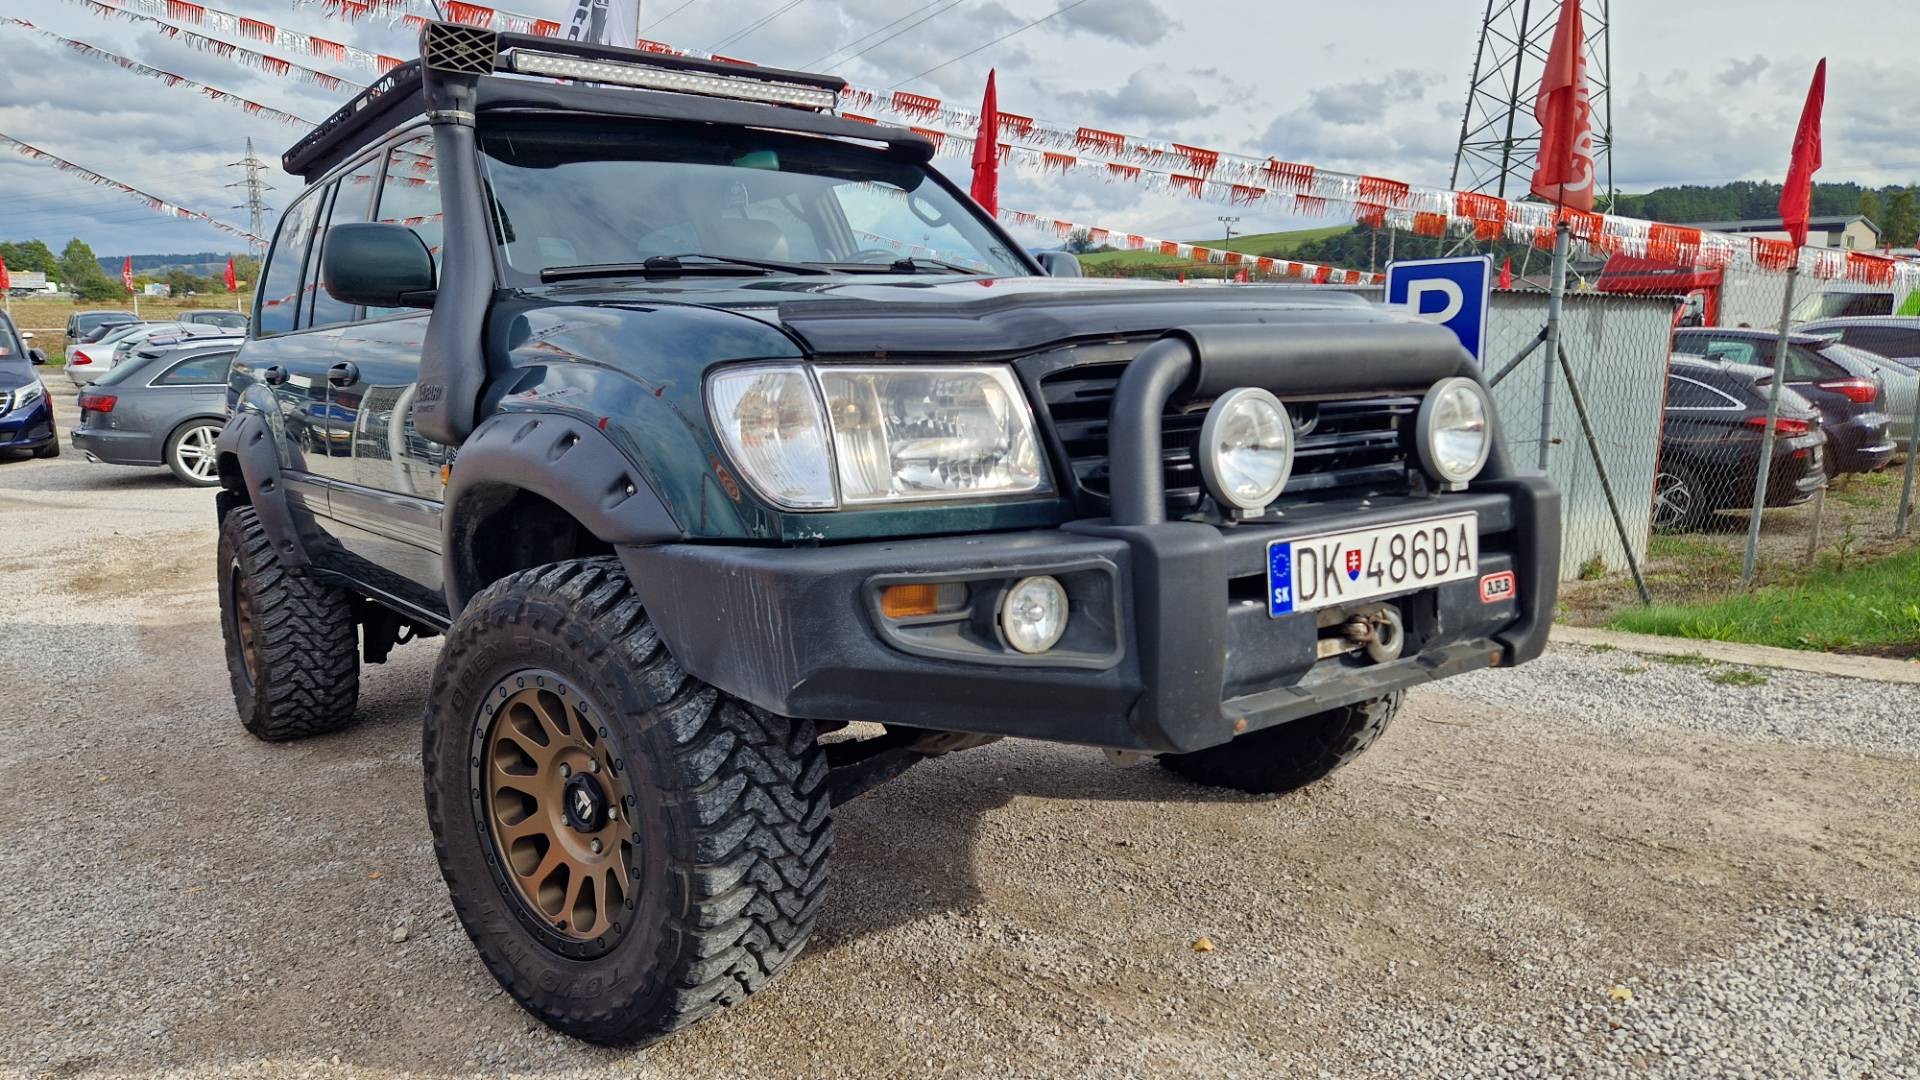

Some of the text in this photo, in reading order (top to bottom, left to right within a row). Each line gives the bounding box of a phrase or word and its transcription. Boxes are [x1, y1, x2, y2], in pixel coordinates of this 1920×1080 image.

[1407, 278, 1463, 324] P
[1297, 523, 1471, 601] DK 486BA
[1274, 586, 1290, 604] SK
